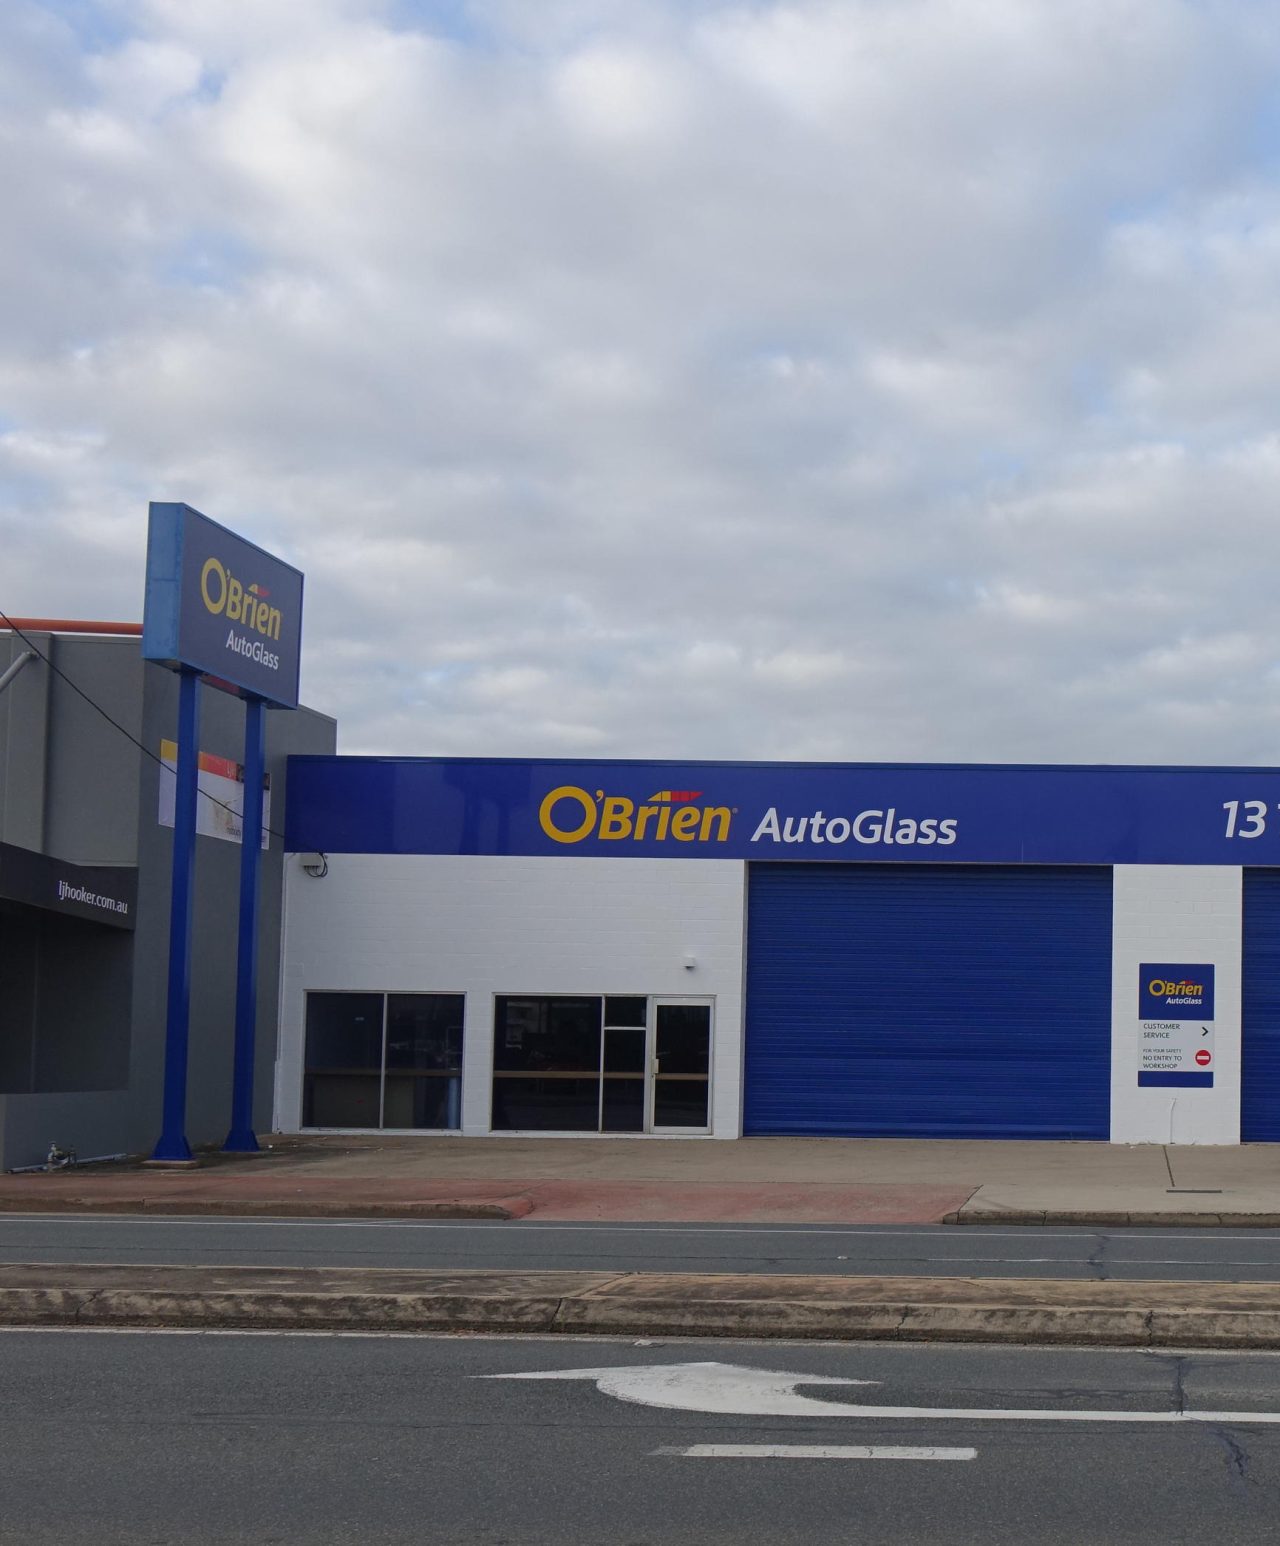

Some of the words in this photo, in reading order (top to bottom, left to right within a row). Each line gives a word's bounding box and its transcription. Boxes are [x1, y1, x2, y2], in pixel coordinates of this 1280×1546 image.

[201, 557, 282, 641] O'Brien
[225, 629, 279, 671] AutoGlass
[539, 786, 735, 844] O'Brien
[750, 807, 958, 846] AutoGlass
[1222, 800, 1268, 839] 13
[58, 880, 128, 914] ljhooker.com.au
[1149, 979, 1203, 996] O'Brien
[1165, 997, 1202, 1005] AutoGlass
